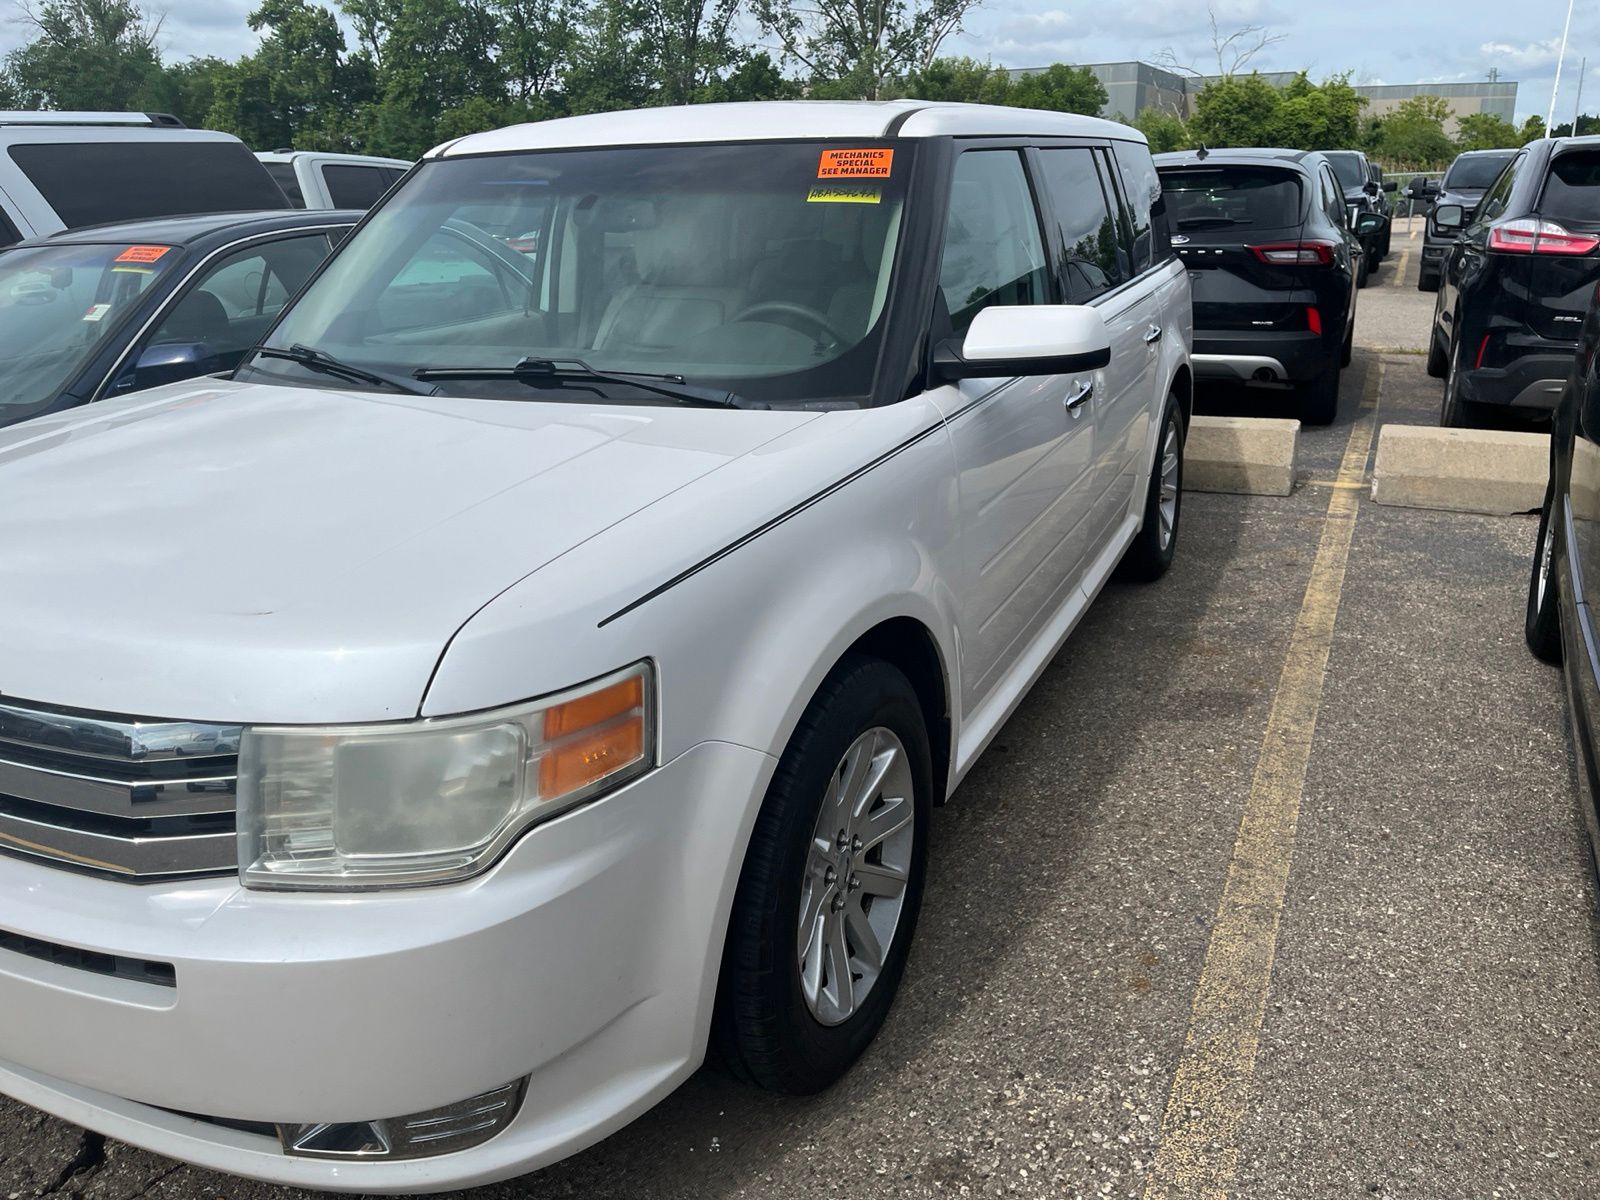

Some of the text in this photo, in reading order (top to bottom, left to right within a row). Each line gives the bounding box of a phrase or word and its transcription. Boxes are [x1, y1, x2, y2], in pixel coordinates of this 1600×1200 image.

[830, 151, 884, 159] MECHANICS
[836, 159, 875, 167] SPECIAL
[840, 167, 888, 175] MANAGER
